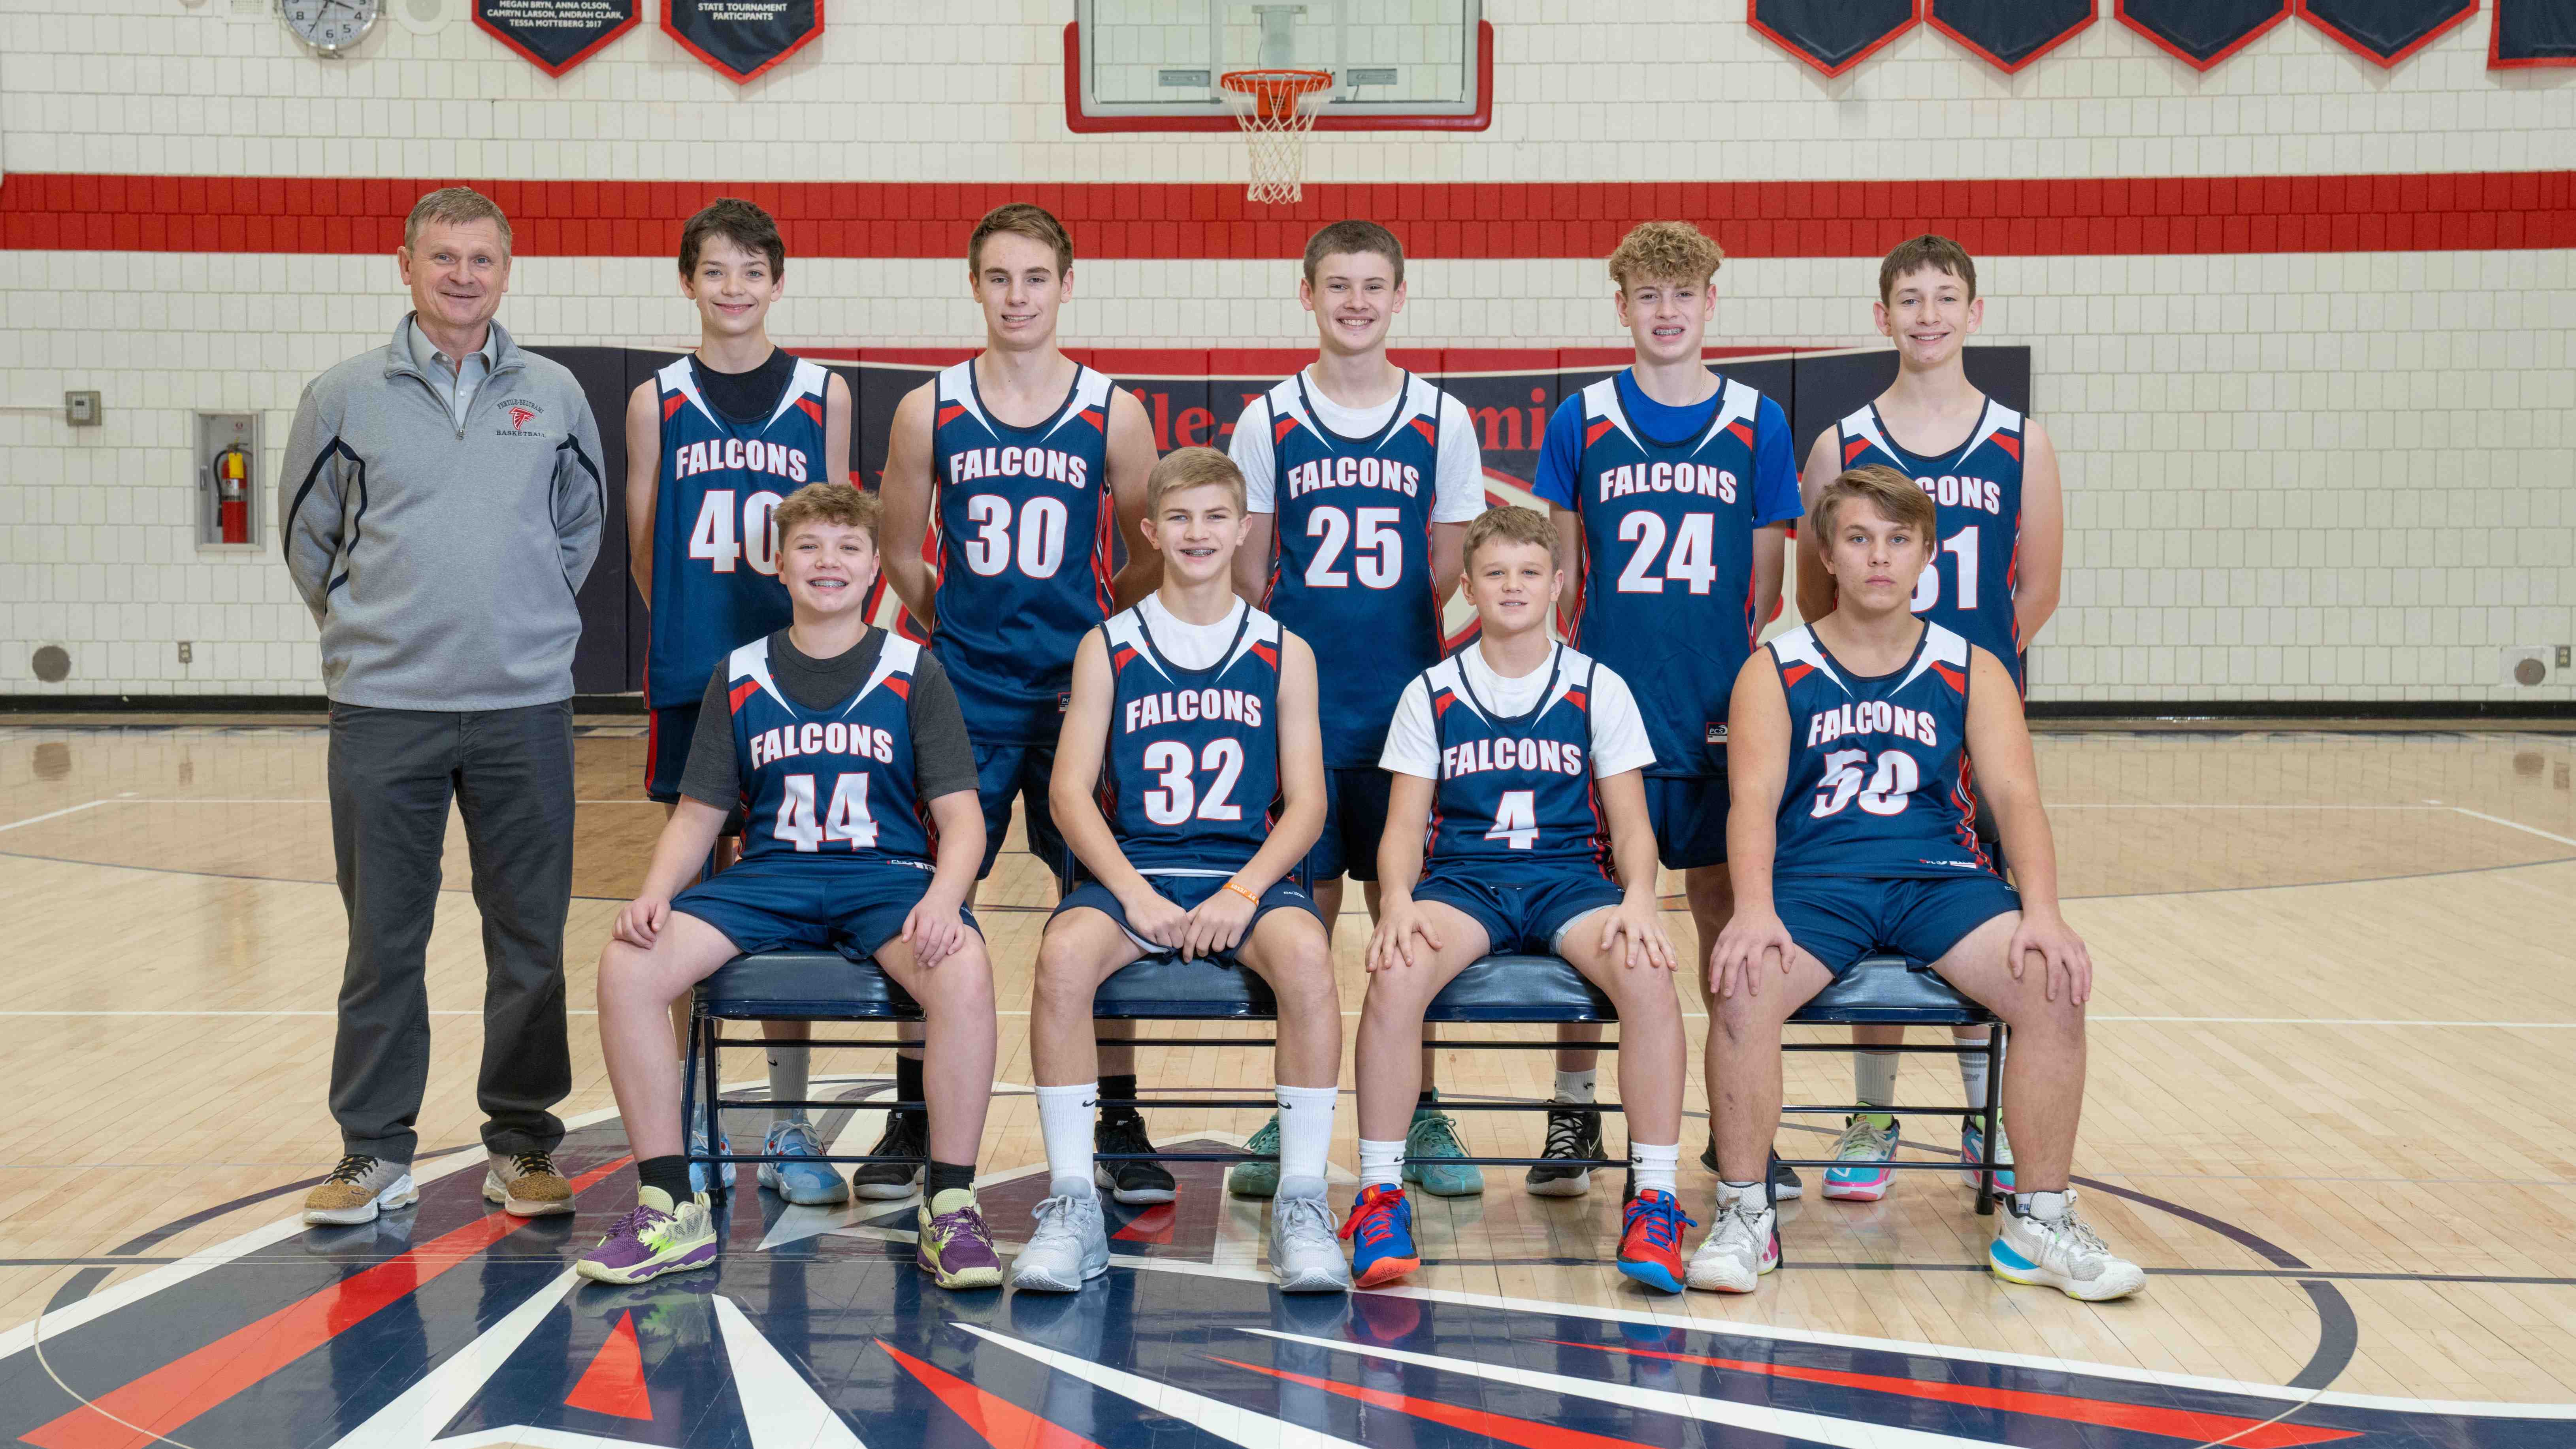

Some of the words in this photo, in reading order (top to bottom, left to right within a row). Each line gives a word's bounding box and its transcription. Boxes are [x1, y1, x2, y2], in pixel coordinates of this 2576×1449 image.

[296, 11, 304, 20] 8
[354, 11, 362, 20] 4
[523, 10, 557, 19] LARSON,
[595, 11, 624, 19] CLARK,
[530, 1, 553, 9] BRYN,
[581, 2, 611, 10] OLSON,
[698, 3, 724, 11] STATE
[726, 3, 788, 11] TOURNAMENT
[326, 30, 334, 38] 6
[343, 24, 351, 33] 5
[676, 438, 807, 482] FALCONS
[950, 447, 1087, 489] FALCONS
[1288, 457, 1419, 499] FALCONS
[1600, 462, 1737, 504] FALCONS
[1915, 475, 2000, 515] CONS
[689, 489, 785, 576] 40
[965, 494, 1068, 579] 30
[1304, 505, 1403, 590] 25
[1617, 510, 1717, 595] 24
[1126, 688, 1262, 734] FALCONS
[1807, 701, 1937, 747] FALCONS
[750, 722, 894, 771] FALCONS
[1443, 737, 1582, 780] FALCONS
[1143, 737, 1244, 827] 32
[1810, 749, 1919, 819] 50
[773, 771, 879, 852] 44
[1484, 790, 1540, 850] 4
